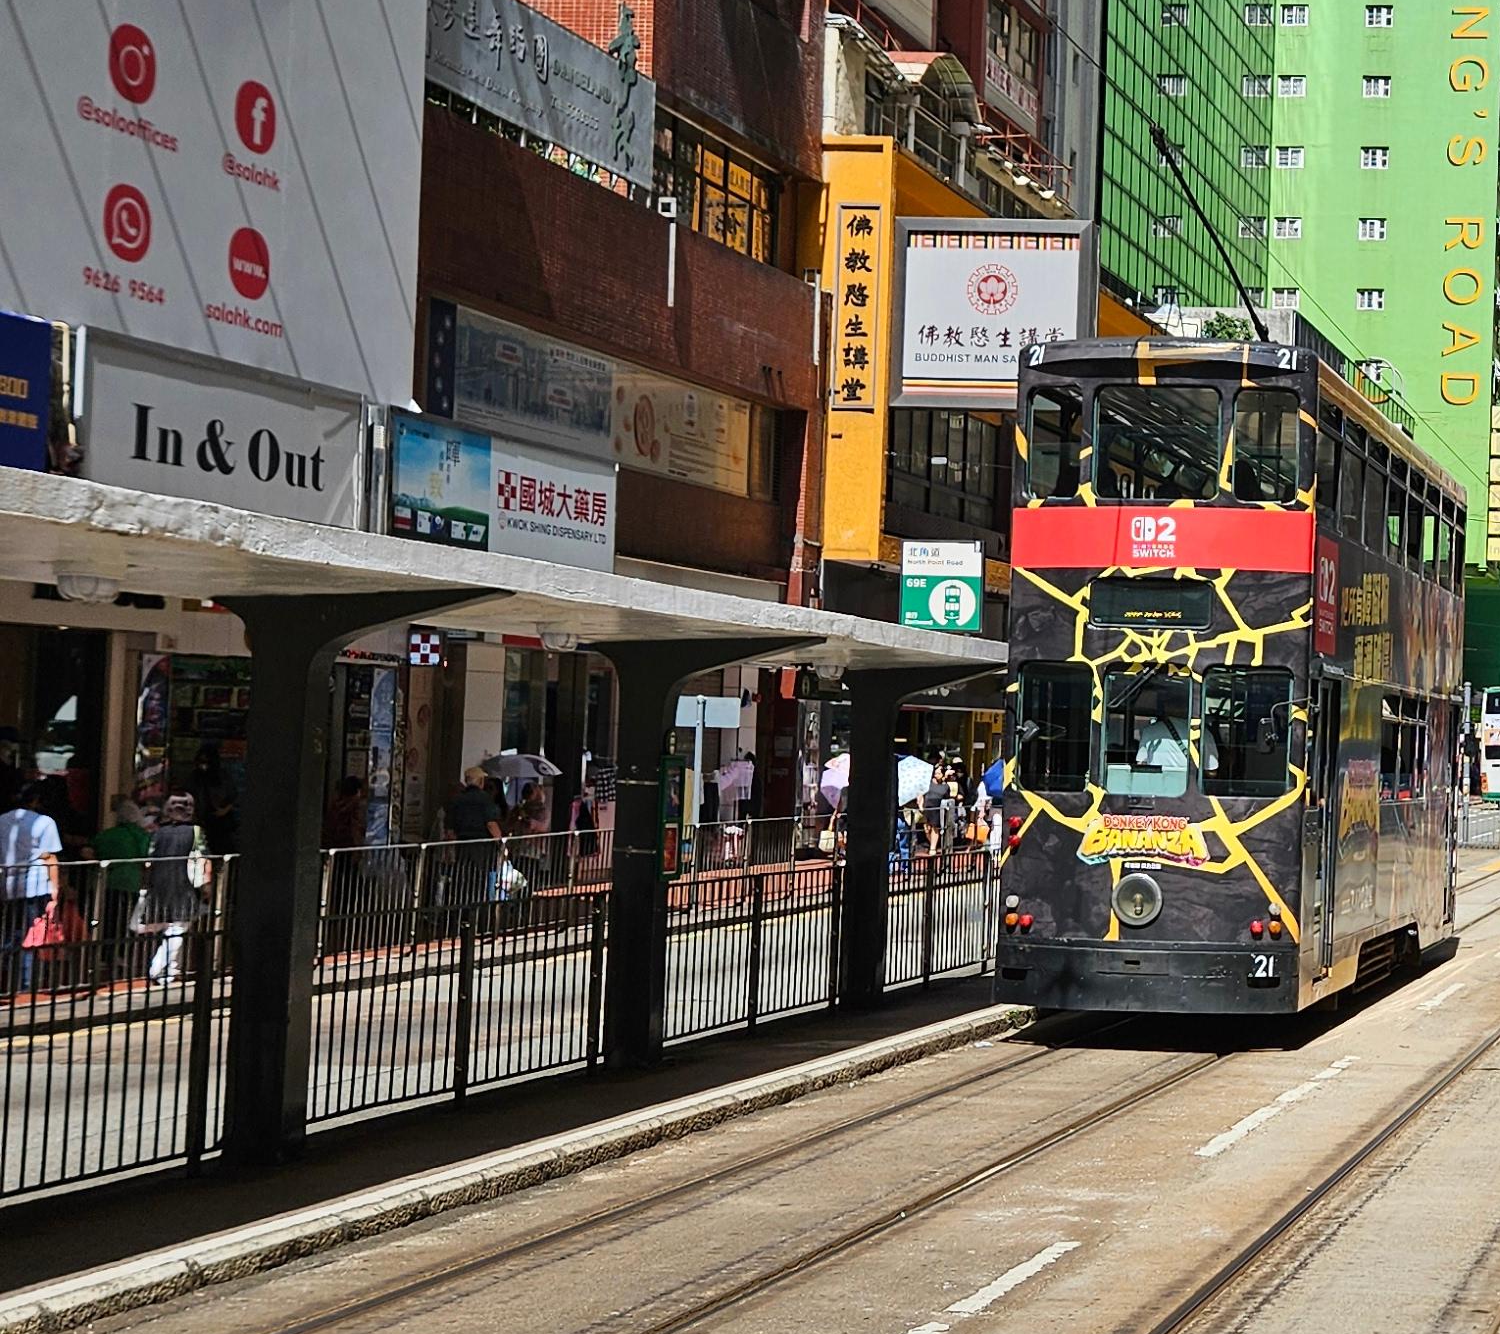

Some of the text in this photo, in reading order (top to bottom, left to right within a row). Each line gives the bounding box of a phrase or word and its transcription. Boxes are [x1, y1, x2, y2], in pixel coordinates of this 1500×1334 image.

[205, 302, 284, 338] solohk.com
[1440, 217, 1484, 406] ROAD
[914, 352, 971, 364] BUDDHIST
[974, 354, 999, 364] MAN
[1029, 344, 1046, 367] 21
[1277, 348, 1298, 371] 21
[130, 402, 326, 492] In & Out
[519, 475, 607, 527] 國城大藥房
[507, 517, 529, 531] KWOK
[530, 521, 551, 536] SHING
[552, 525, 593, 542] DISPENSARY
[1132, 549, 1176, 558] SWITCH
[906, 578, 927, 588] 69E
[1103, 814, 1188, 830] DONKEY KONG
[1081, 827, 1208, 862] BANANZA
[1254, 954, 1275, 978] 21
